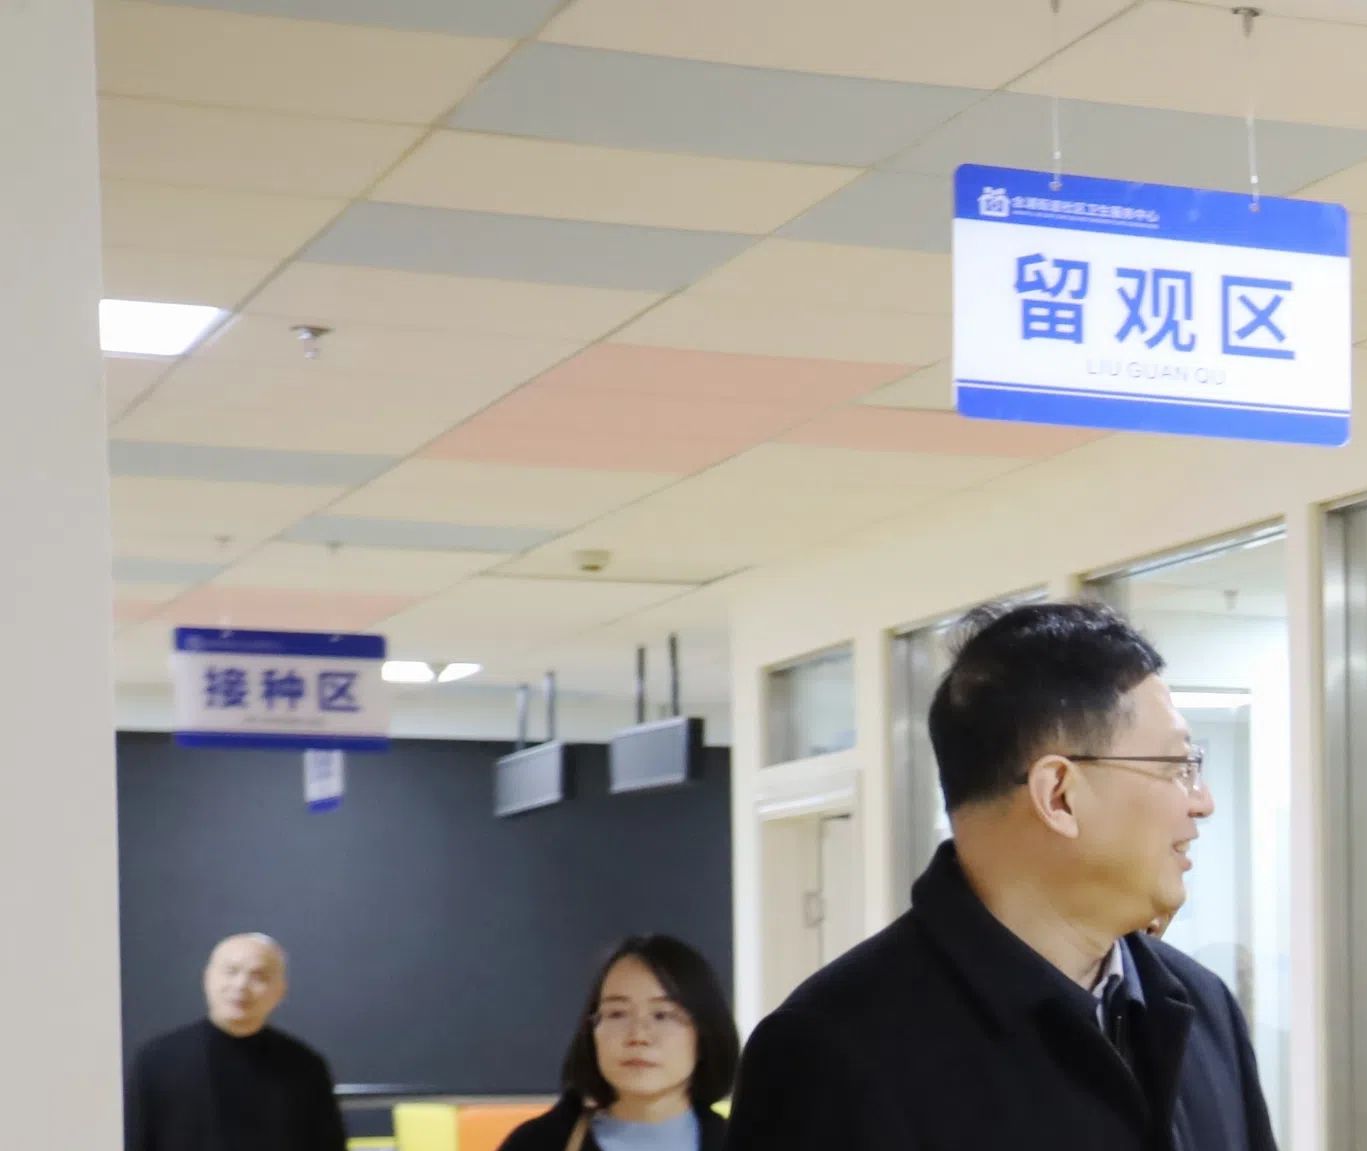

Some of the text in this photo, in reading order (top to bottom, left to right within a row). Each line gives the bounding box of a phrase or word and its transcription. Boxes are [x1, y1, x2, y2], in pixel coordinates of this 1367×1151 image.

[1015, 252, 1296, 360] 留观区
[1086, 358, 1226, 386] LIU GUAN QU
[204, 666, 362, 712] 接种区
